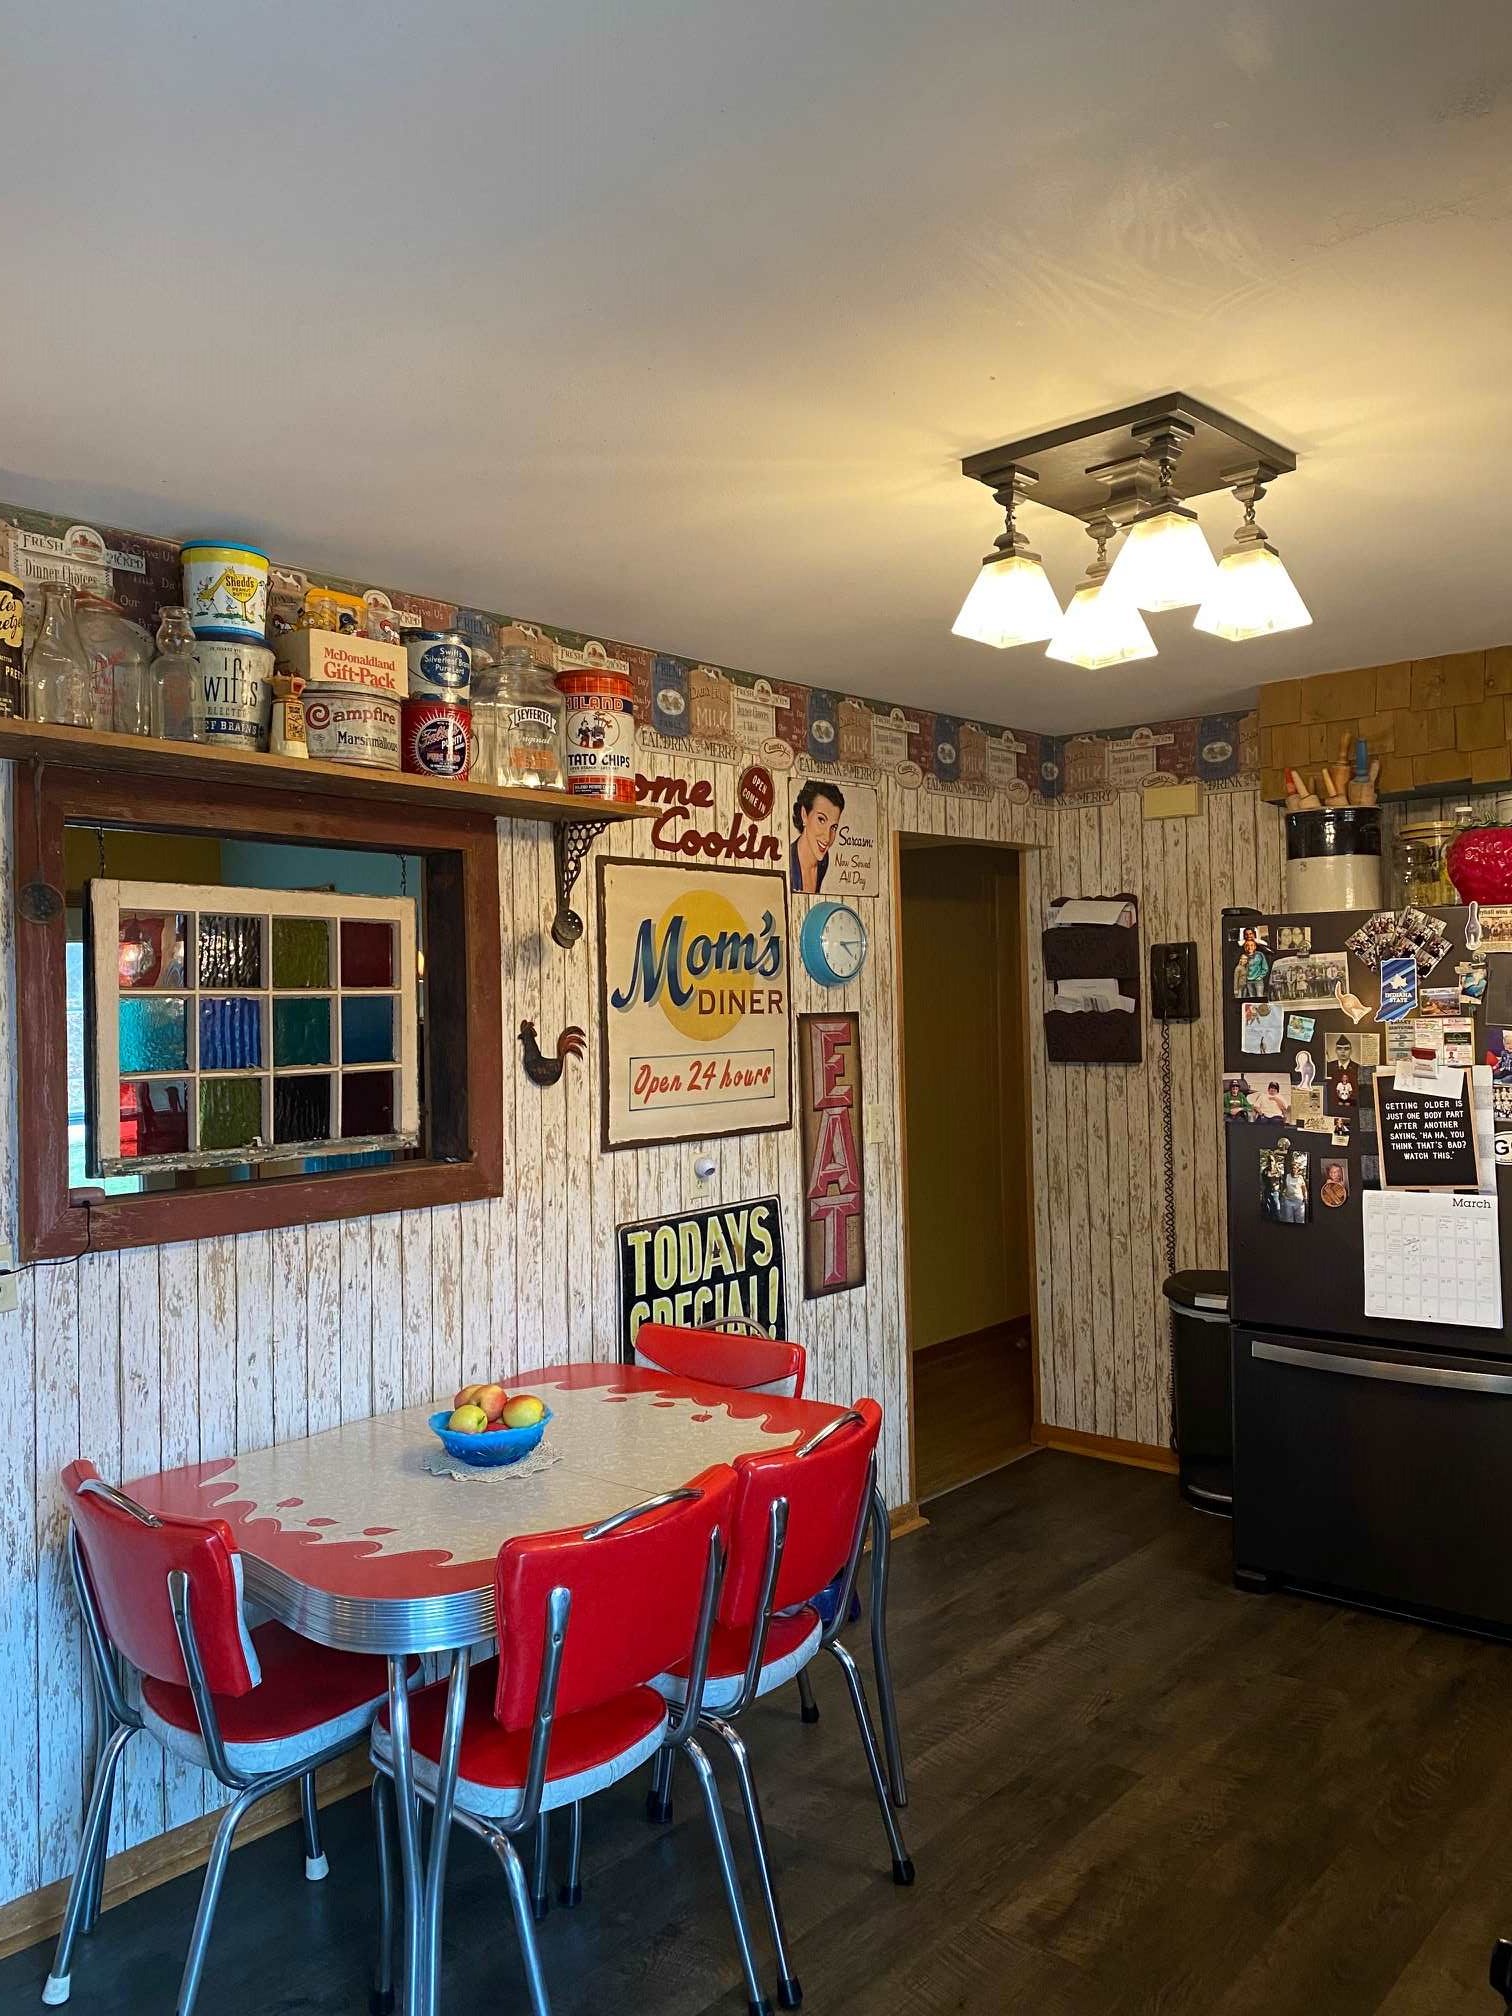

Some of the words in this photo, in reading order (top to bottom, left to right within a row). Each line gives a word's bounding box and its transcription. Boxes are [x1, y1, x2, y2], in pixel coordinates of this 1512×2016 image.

[22, 533, 64, 552] FRESH
[24, 558, 61, 580] Dinner
[62, 564, 98, 587] Choices
[225, 575, 255, 589] Shedd's
[323, 647, 396, 672] McDonaldland
[323, 661, 396, 690] Gift-Pack
[305, 702, 397, 731] Campfire
[696, 705, 728, 730] MILK
[220, 721, 257, 735] BRAINS
[704, 740, 737, 761] MERRY
[843, 734, 868, 754] MILK
[568, 753, 597, 767] TATO
[602, 754, 631, 769] CHIPS
[635, 773, 714, 808] ome
[752, 775, 769, 795] OPEN
[742, 787, 758, 807] COME
[757, 802, 767, 815] IN
[1075, 790, 1112, 803] MERRY
[651, 805, 783, 862] Cookin
[834, 853, 849, 868] Now
[850, 854, 872, 869] Served
[839, 870, 851, 884] All
[852, 871, 867, 891] Day
[610, 910, 781, 1009] Mom's
[698, 989, 784, 1015] DINER
[632, 1063, 682, 1104] Open
[687, 1060, 717, 1092] 24
[719, 1058, 772, 1090] hours
[1385, 1102, 1418, 1110] GETTING
[1424, 1100, 1450, 1109] OLDER
[1386, 1112, 1404, 1120] JUST
[1406, 1112, 1421, 1120] ONE
[1424, 1111, 1442, 1119] BODY
[1445, 1110, 1464, 1118] PART
[1393, 1122, 1418, 1130] AFTER
[1424, 1120, 1459, 1129] ANOTHER
[1450, 1131, 1465, 1139] YOU
[808, 1021, 861, 1288] EAT
[1391, 1142, 1413, 1150] THINK
[1416, 1141, 1443, 1149] THAT'S
[1447, 1140, 1467, 1149] BAD?
[1495, 1139, 1512, 1156] G
[1403, 1152, 1429, 1160] WATCH
[1452, 1198, 1492, 1209] March
[627, 1205, 774, 1297] TODAYS
